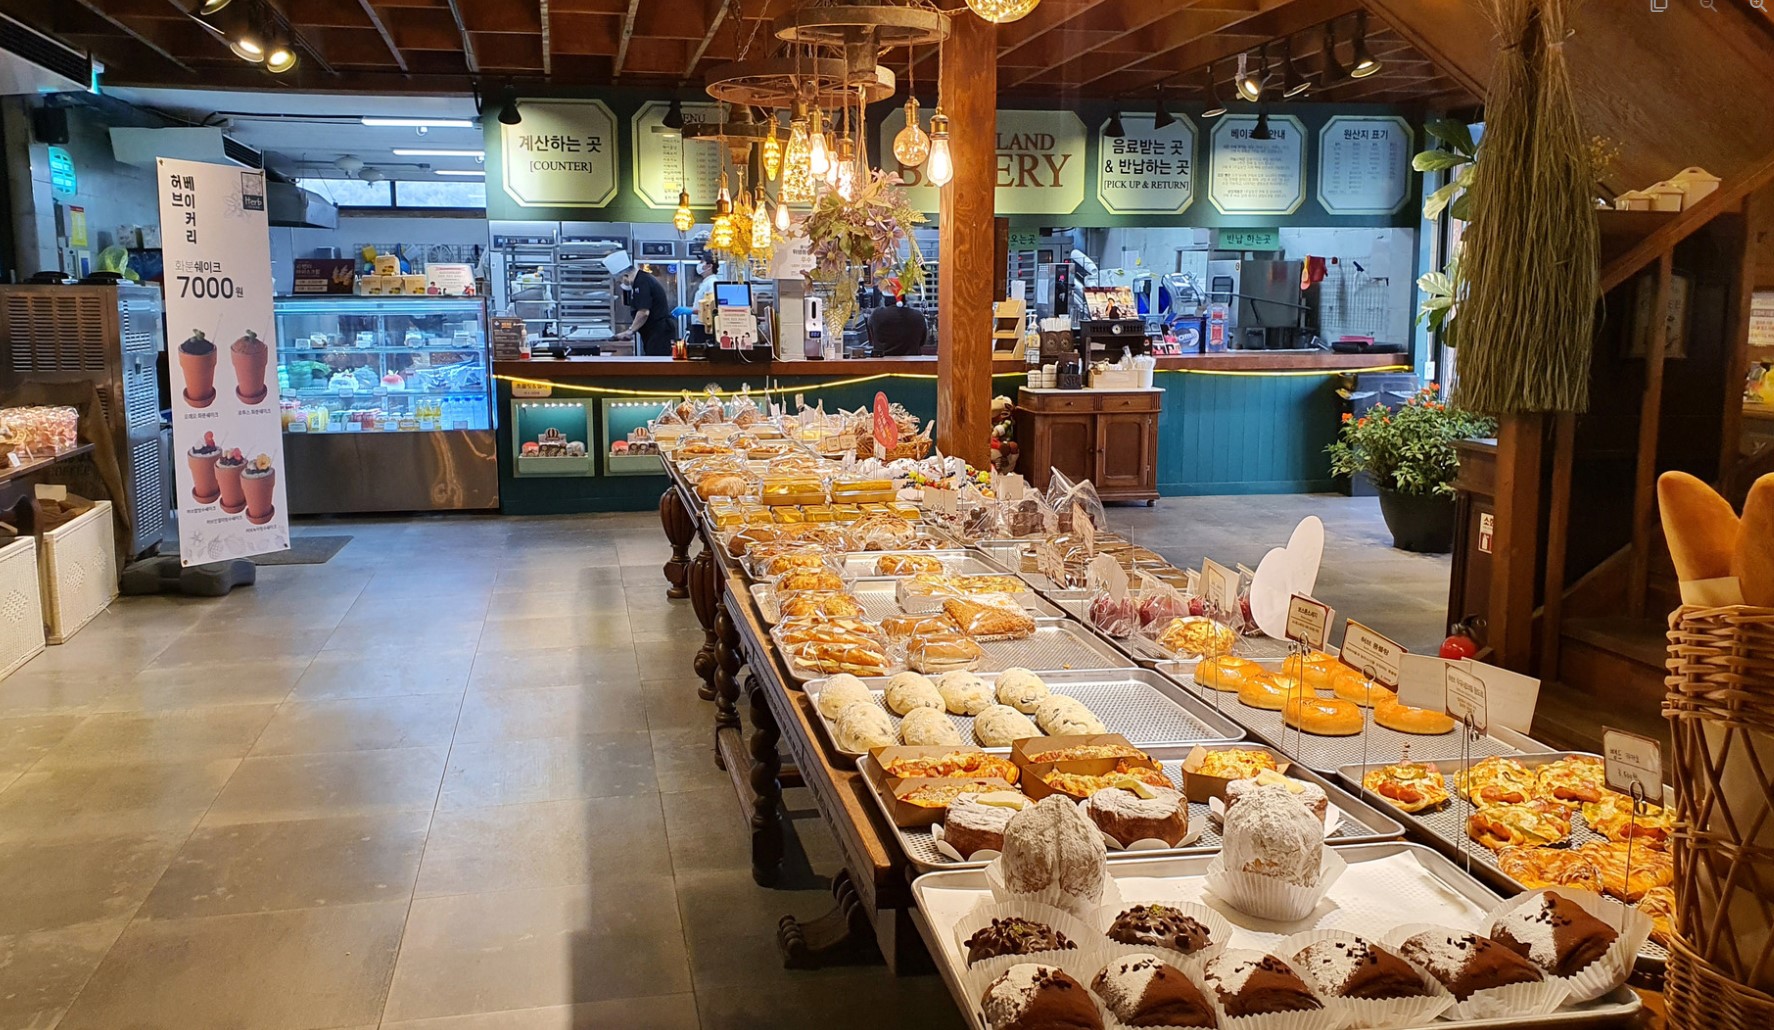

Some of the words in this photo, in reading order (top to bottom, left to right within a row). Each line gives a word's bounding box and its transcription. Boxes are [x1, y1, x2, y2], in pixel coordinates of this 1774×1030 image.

[682, 113, 706, 123] ENU
[997, 132, 1055, 150] LAND
[1344, 129, 1369, 140] 원산지
[1371, 129, 1389, 140] 표기
[519, 135, 581, 152] 계산하는
[586, 136, 602, 153] 곳
[1112, 138, 1166, 155] 음료받는
[1170, 140, 1184, 155] 곳
[530, 161, 592, 173] [COUNTER]
[895, 154, 1072, 187] BERY
[1104, 159, 1114, 173] &
[1119, 159, 1172, 175] 반납하는
[1176, 160, 1190, 175] 곳
[170, 174, 184, 207] 허브
[1104, 180, 1127, 190] [PICK
[1129, 180, 1141, 189] UP
[1142, 180, 1149, 189] &
[1151, 180, 1189, 191] RETURN]
[245, 196, 262, 206] Herb
[183, 176, 197, 244] 베이커리
[1226, 233, 1243, 244] 반납
[175, 260, 222, 273] 화분쉐이크
